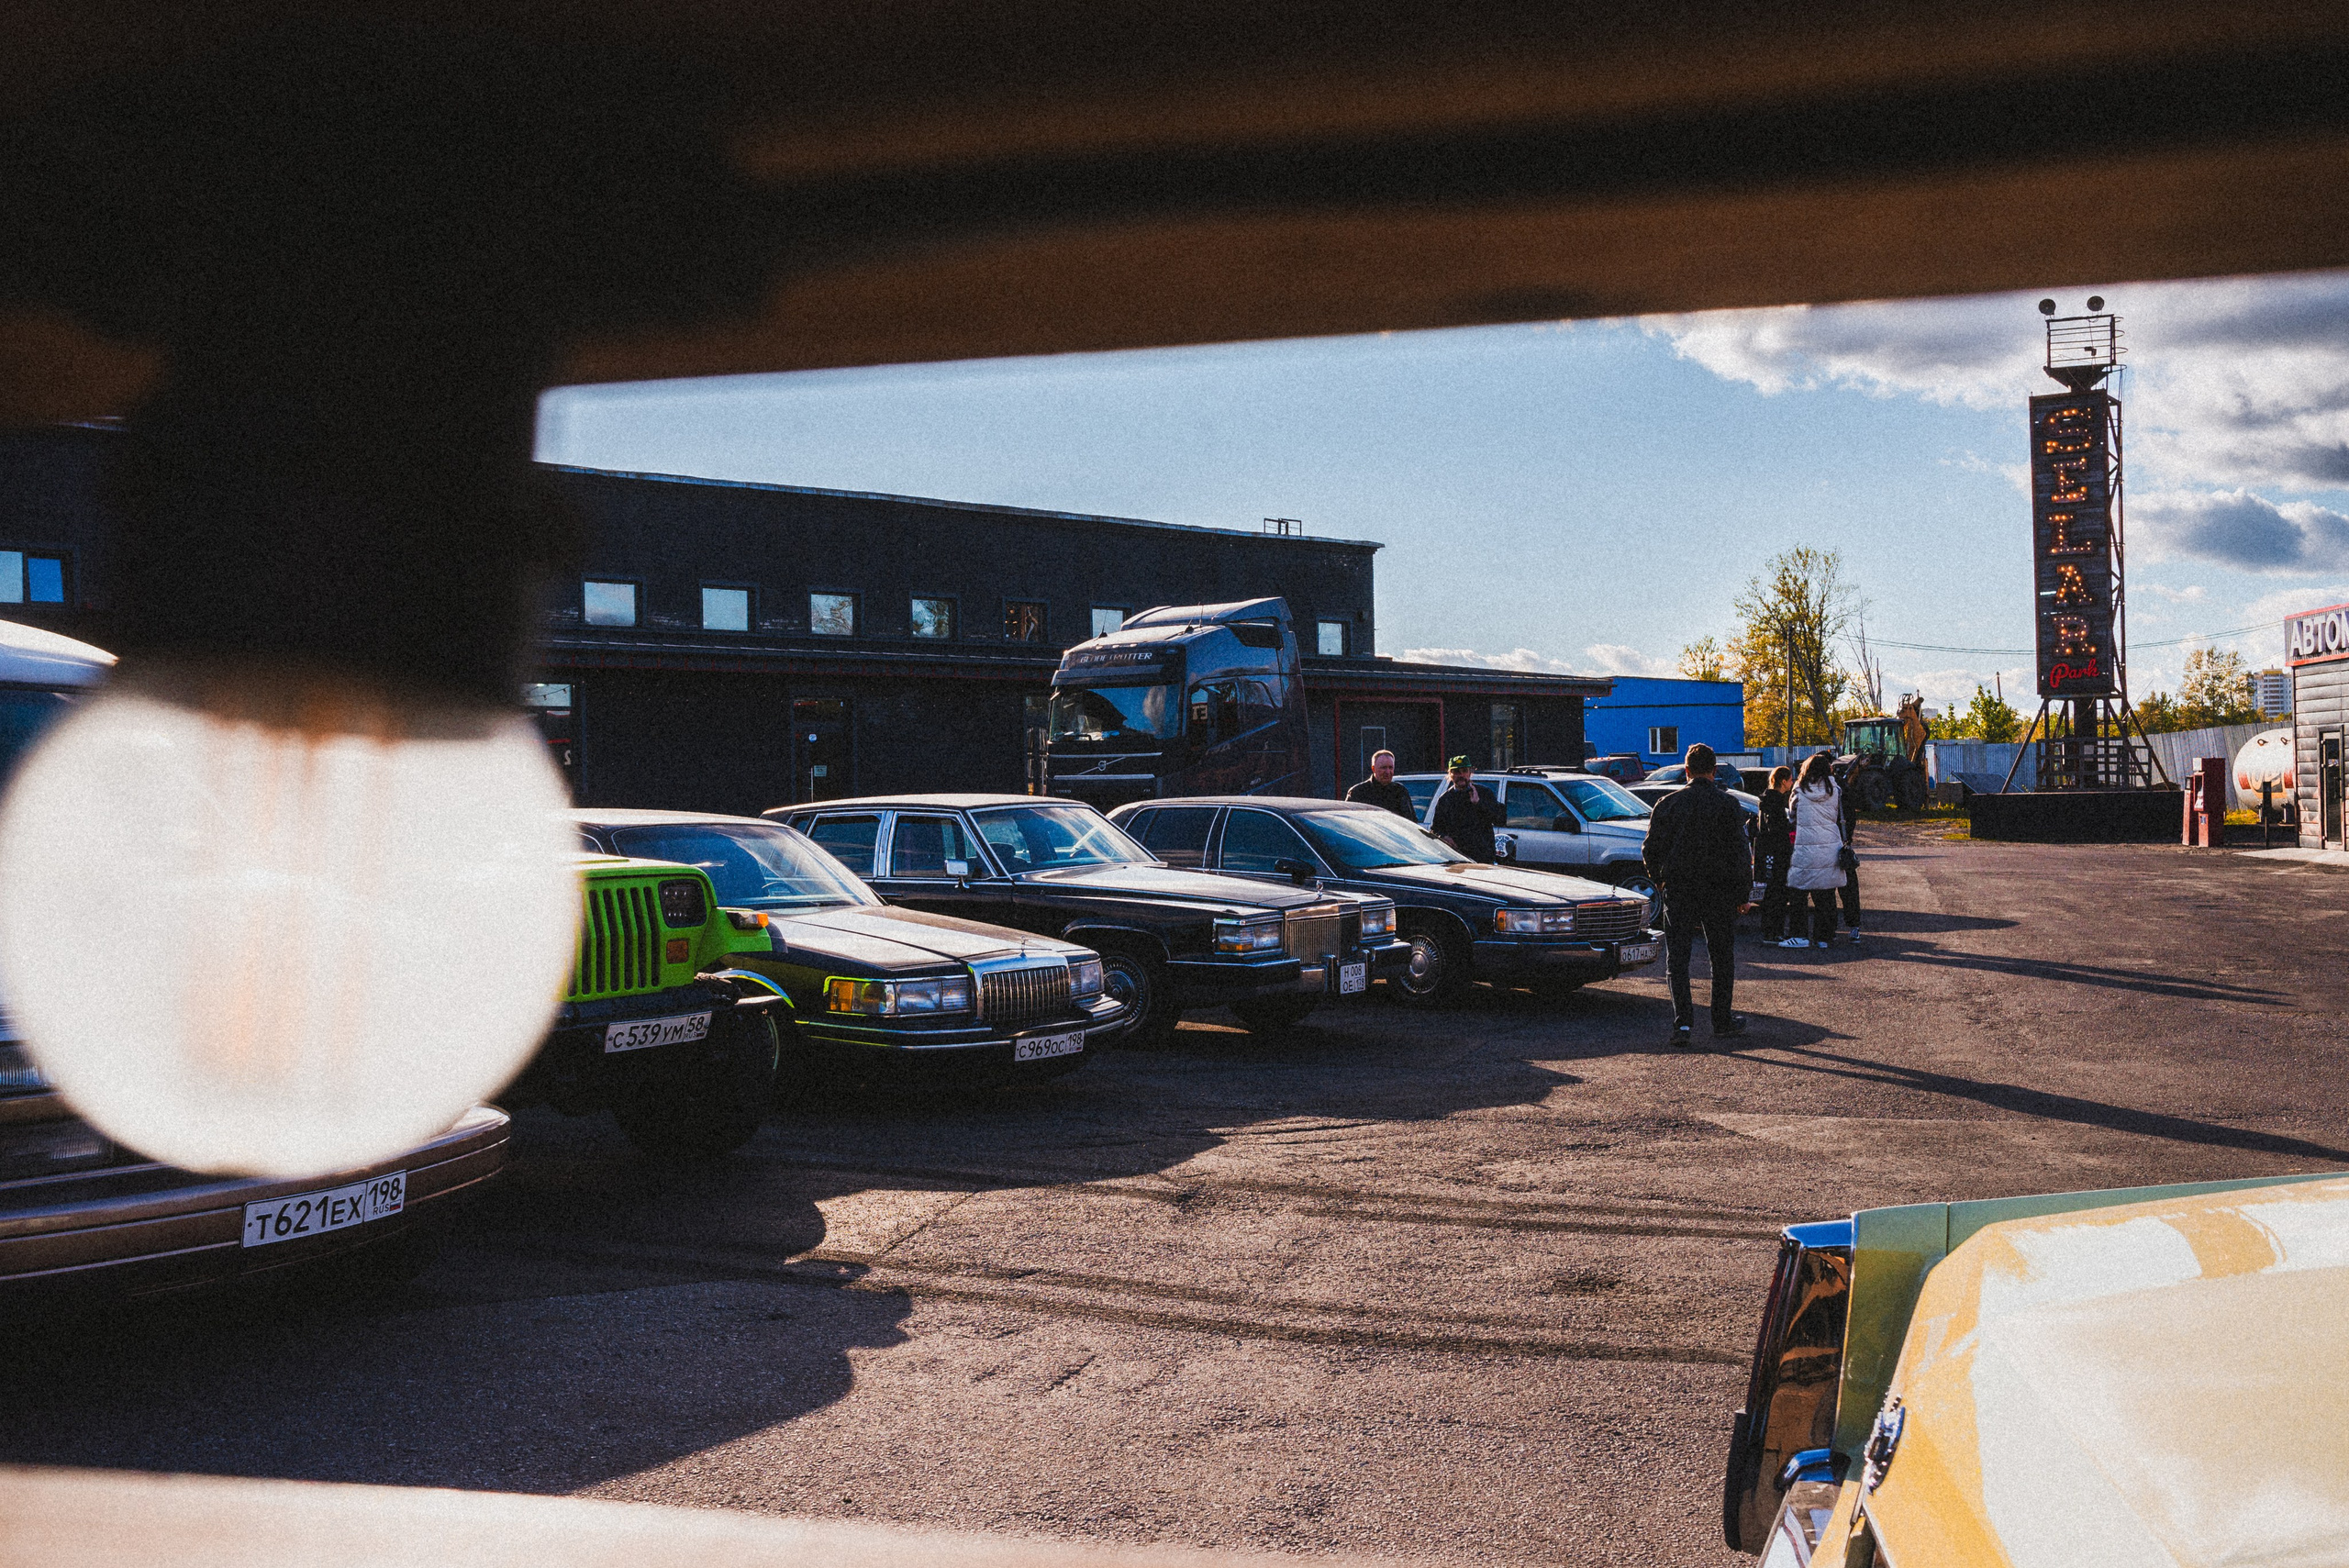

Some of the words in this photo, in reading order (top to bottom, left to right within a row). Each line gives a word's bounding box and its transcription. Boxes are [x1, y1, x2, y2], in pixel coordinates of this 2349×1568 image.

[2042, 406, 2098, 655] SELAR
[2049, 658, 2100, 688] Park
[613, 1024, 685, 1048] С539УМ
[687, 1016, 705, 1033] 58
[1019, 1039, 1065, 1058] С969ОС
[1068, 1032, 1083, 1047] 198
[256, 1194, 363, 1240] Т621ЕХ
[368, 1177, 400, 1207] 198
[373, 1204, 390, 1216] RUS
